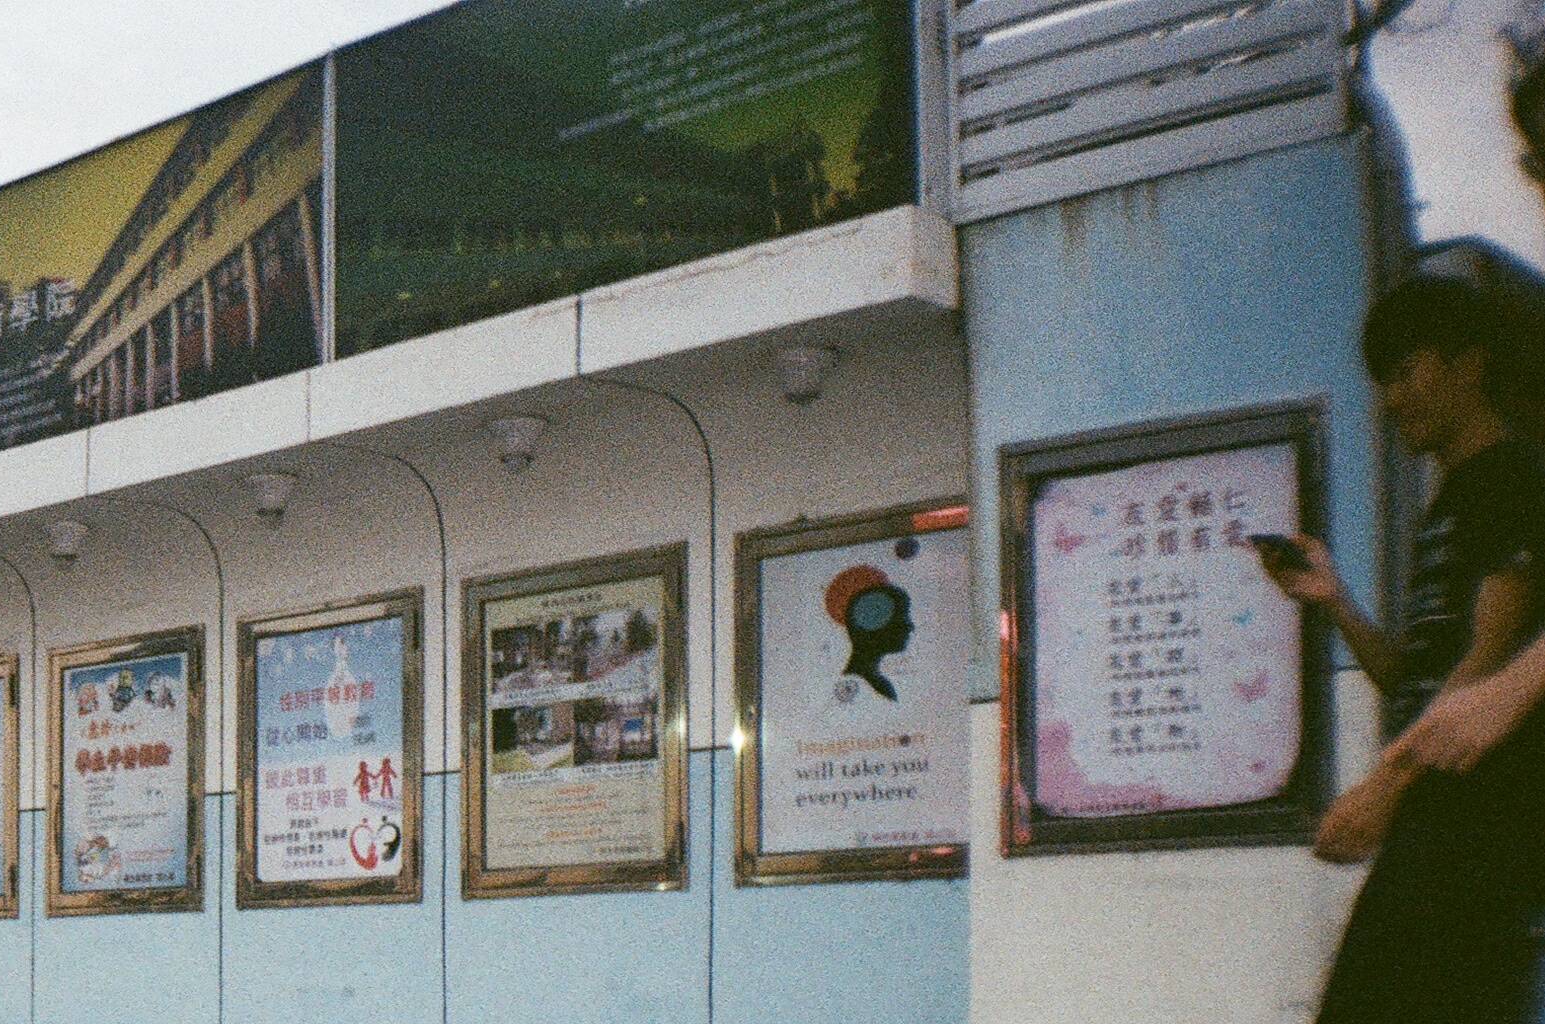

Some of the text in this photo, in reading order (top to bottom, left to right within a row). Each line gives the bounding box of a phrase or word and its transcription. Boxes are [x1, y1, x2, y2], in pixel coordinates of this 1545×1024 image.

[796, 731, 926, 757] Imagination
[795, 756, 930, 781] will take you
[795, 780, 918, 808] everywhere
